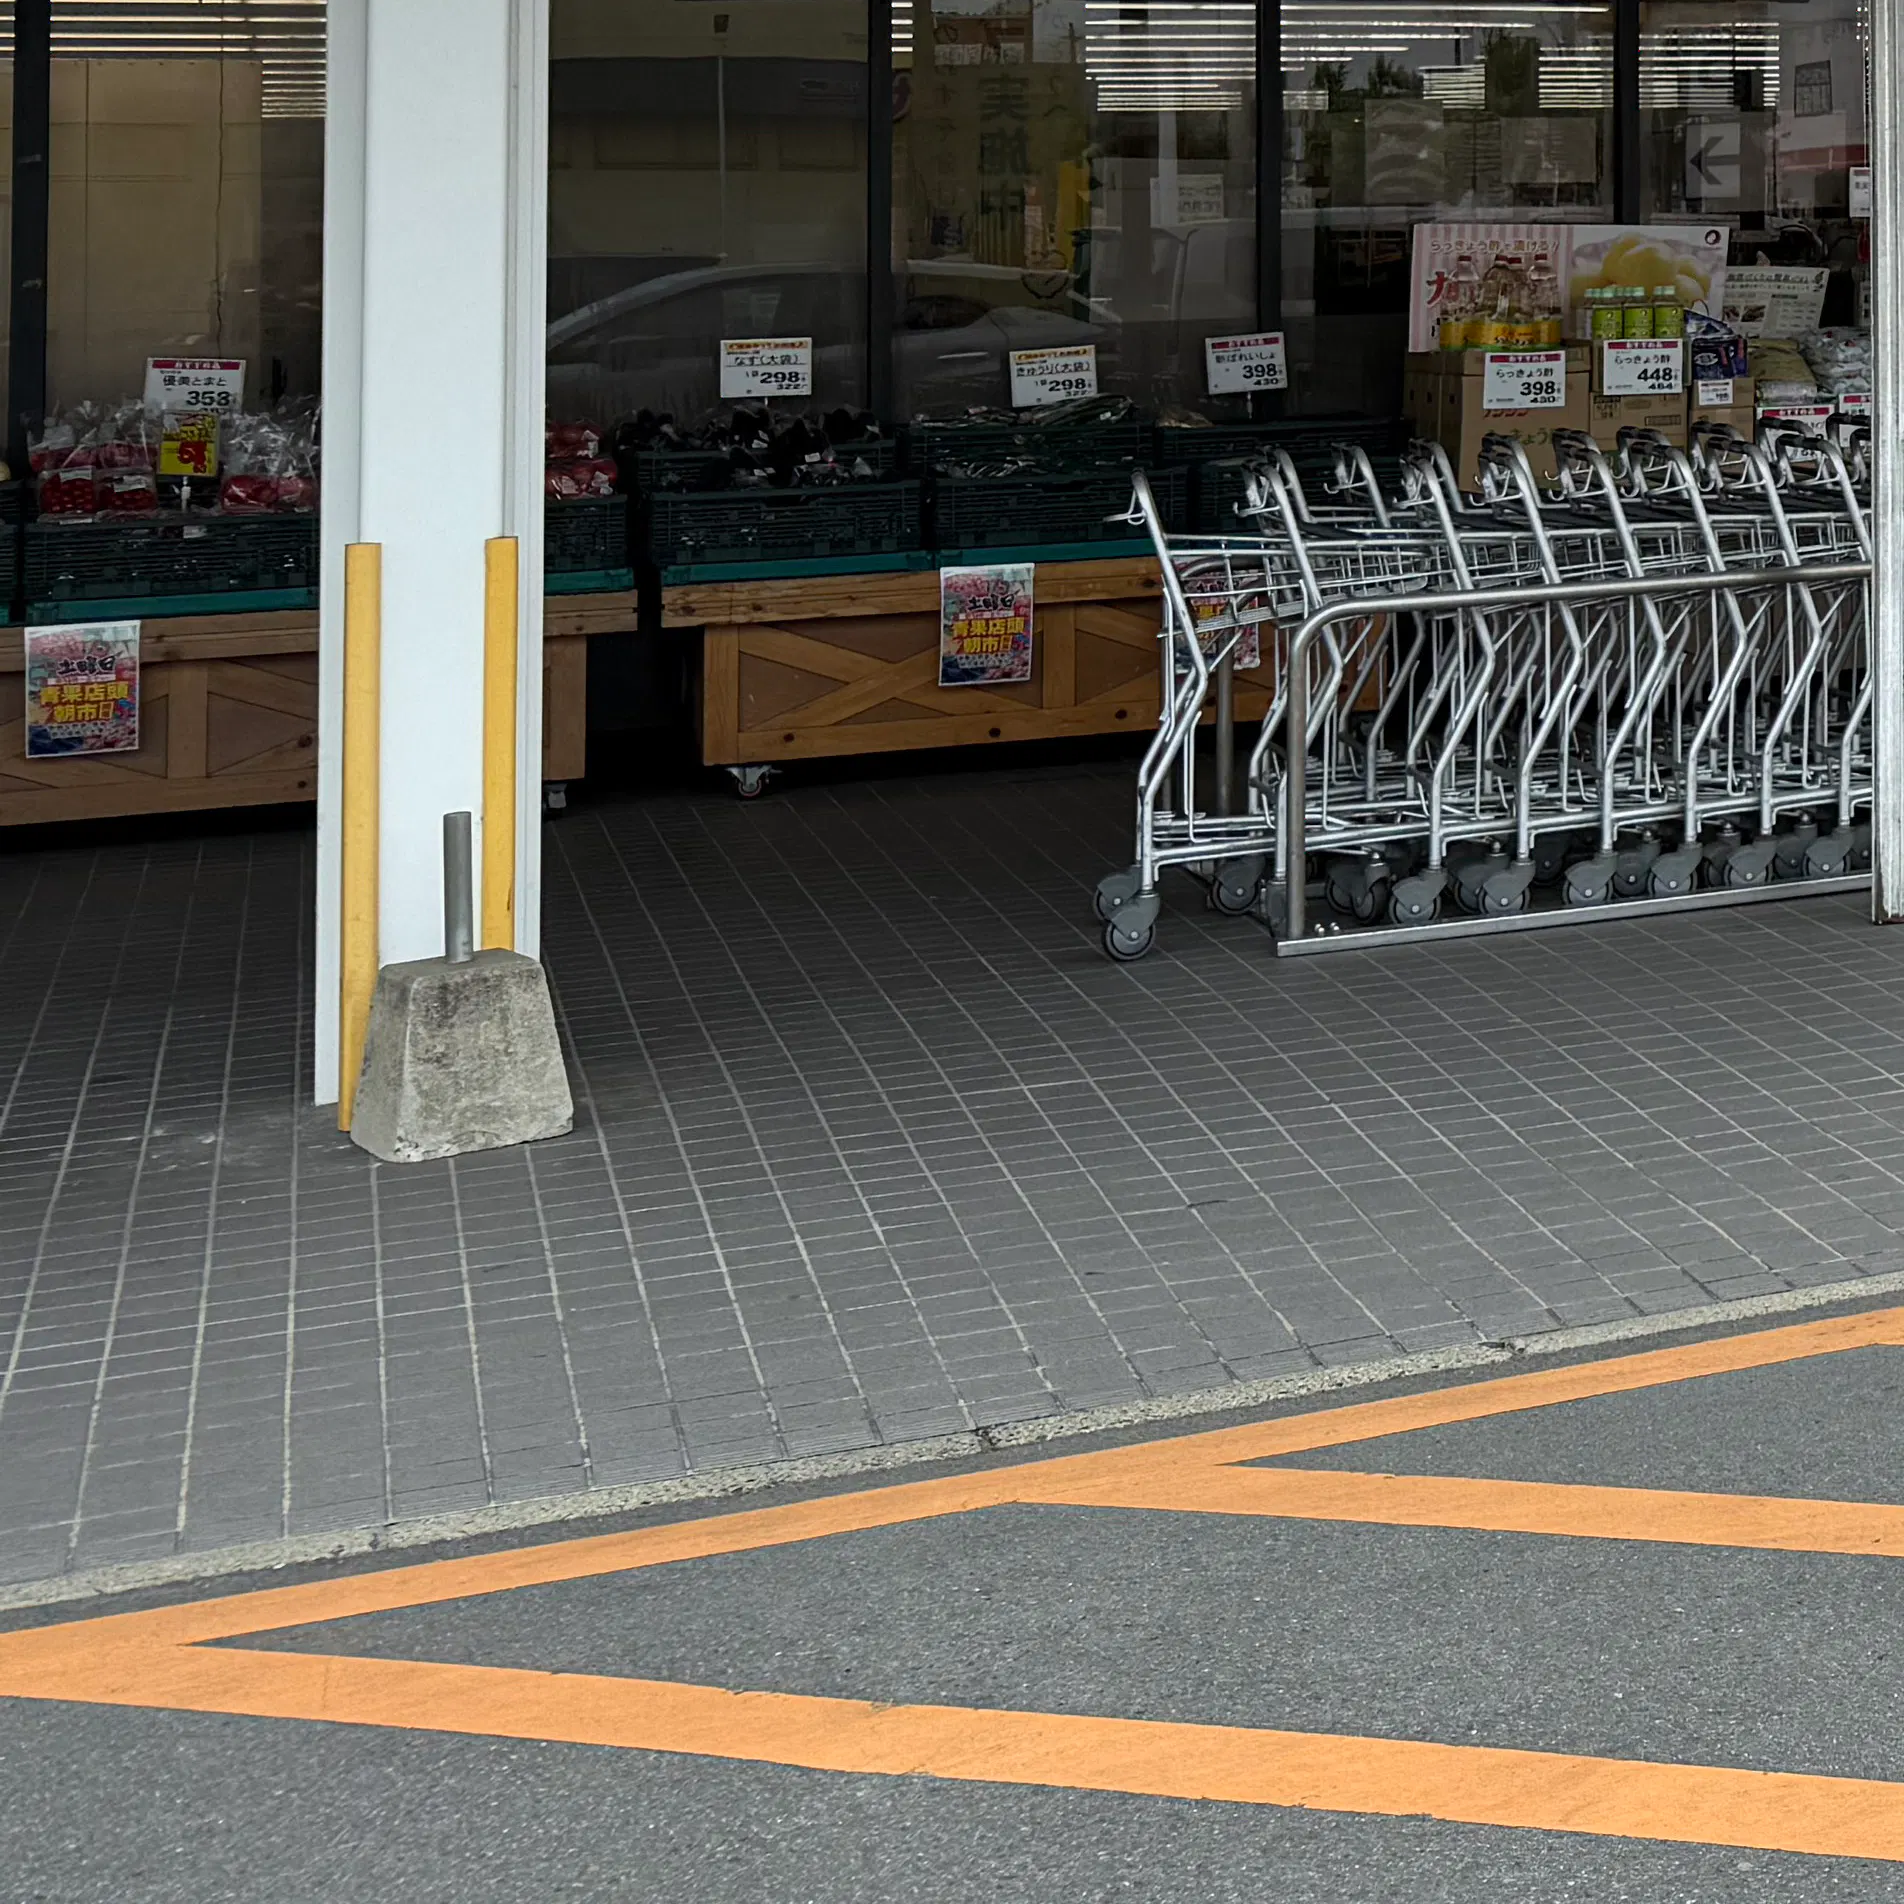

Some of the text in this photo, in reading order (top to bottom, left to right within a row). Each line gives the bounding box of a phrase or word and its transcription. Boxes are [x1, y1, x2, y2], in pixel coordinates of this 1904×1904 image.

[1242, 363, 1278, 379] 398
[1637, 367, 1673, 381] 448
[1520, 381, 1556, 396] 398
